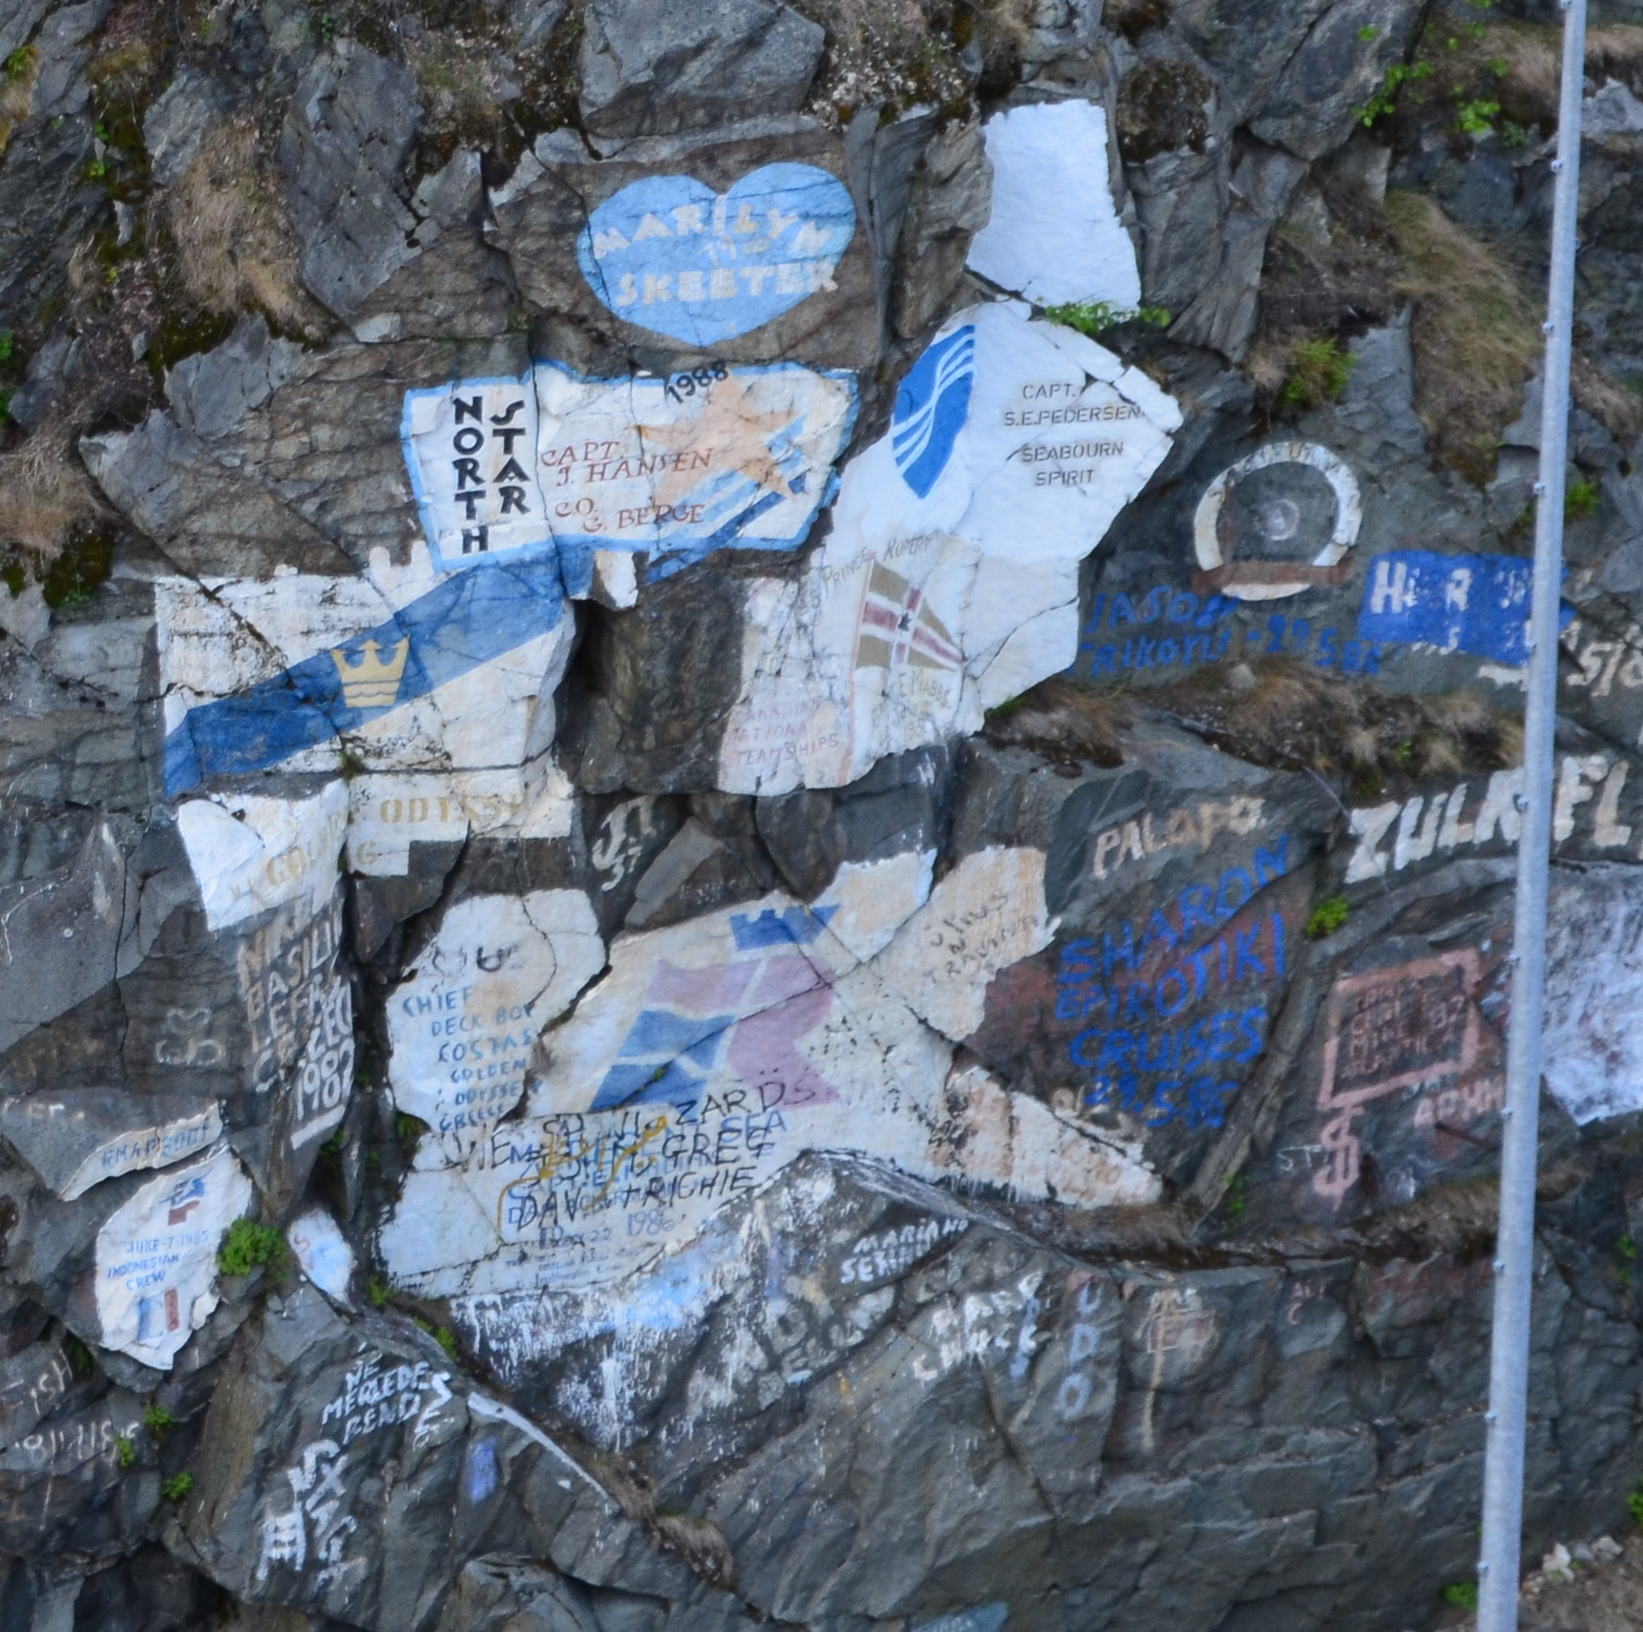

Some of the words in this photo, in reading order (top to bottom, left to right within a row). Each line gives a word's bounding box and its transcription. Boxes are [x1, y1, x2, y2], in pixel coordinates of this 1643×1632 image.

[665, 361, 730, 405] 1988
[1022, 383, 1076, 401] CAPT.
[489, 400, 530, 515] STAR
[583, 447, 715, 483] HANSEN
[1021, 439, 1124, 464] SEABOURN
[452, 396, 488, 554] NORTH
[1034, 467, 1096, 487] SPIRIT
[616, 502, 707, 529] BERGE
[1058, 834, 1289, 983] SHARON
[1055, 913, 1285, 1022] EPIROTIKI
[403, 986, 471, 1018] CHIEF
[432, 1014, 480, 1037] DECK
[1069, 1006, 1267, 1075] CRUISES
[438, 1027, 531, 1062] COSTAS
[126, 1270, 167, 1290] CREW
